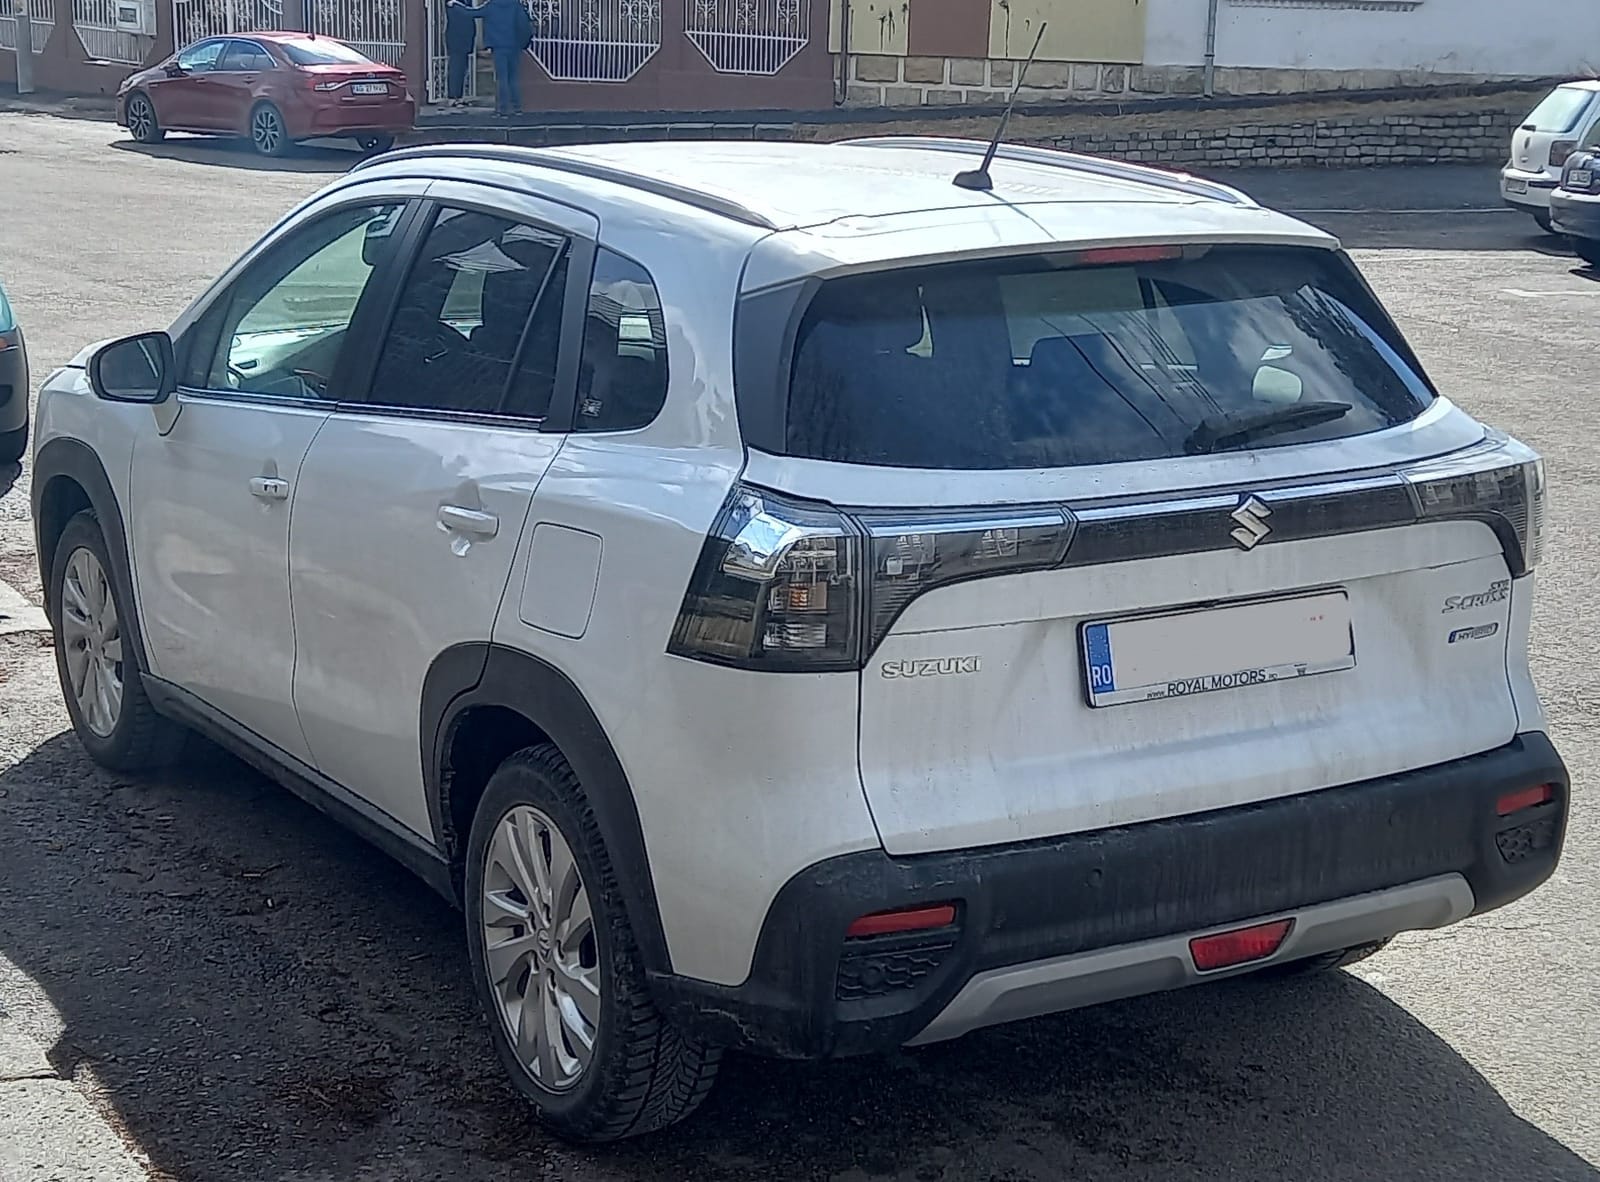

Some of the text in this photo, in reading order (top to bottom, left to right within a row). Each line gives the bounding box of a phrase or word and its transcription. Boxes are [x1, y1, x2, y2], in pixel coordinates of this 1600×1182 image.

[881, 656, 981, 679] SUZUKI
[1091, 667, 1112, 687] RO
[1167, 677, 1208, 697] ROYAL
[1211, 669, 1266, 690] MOTORS
